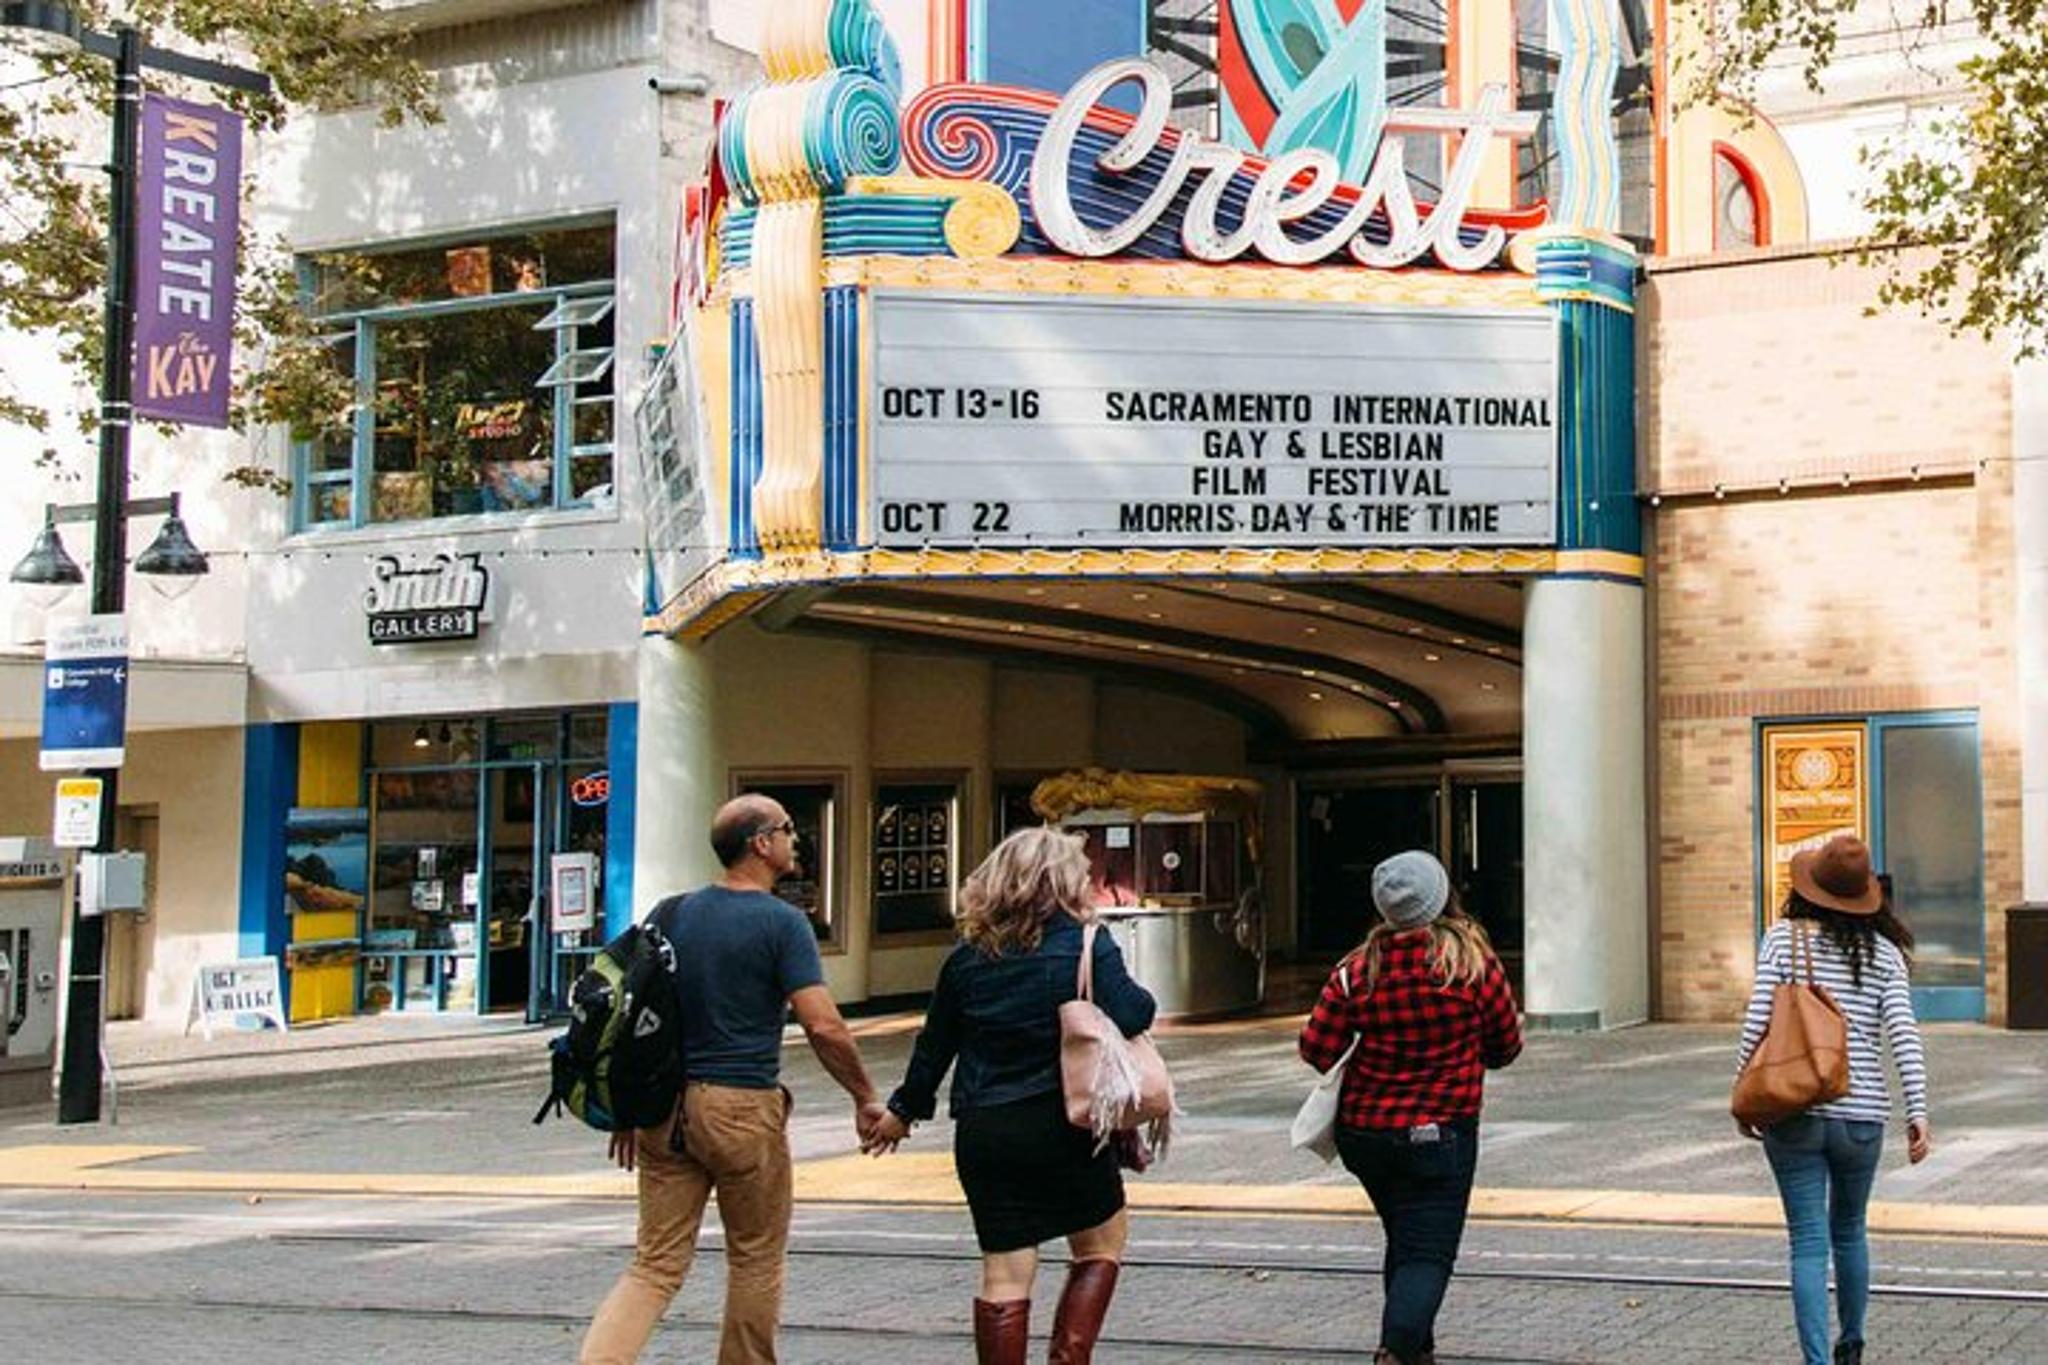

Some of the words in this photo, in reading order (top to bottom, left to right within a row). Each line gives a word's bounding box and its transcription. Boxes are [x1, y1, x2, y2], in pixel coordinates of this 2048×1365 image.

[1030, 56, 1542, 272] Crest
[158, 111, 218, 322] KREATE
[148, 345, 217, 399] KAY
[883, 388, 945, 418] OCT
[956, 388, 1040, 419] 13-16
[1105, 392, 1312, 422] SACRAMENTO
[1333, 394, 1552, 427] INTERNATIONAL
[1204, 430, 1267, 459] GAY
[1287, 430, 1306, 458] &
[1321, 432, 1443, 461] LESBIAN
[1193, 467, 1267, 496] FILM
[1308, 468, 1450, 496] FESTIVAL
[883, 502, 946, 533] OCT
[972, 502, 1010, 533] 22
[1119, 503, 1236, 533] MORRIS
[1250, 504, 1314, 533] DAY
[1328, 503, 1346, 532] &
[1360, 504, 1410, 533] THE
[1427, 504, 1499, 533] TIME
[372, 612, 470, 638] GALLERY
[571, 778, 610, 800] OPE
